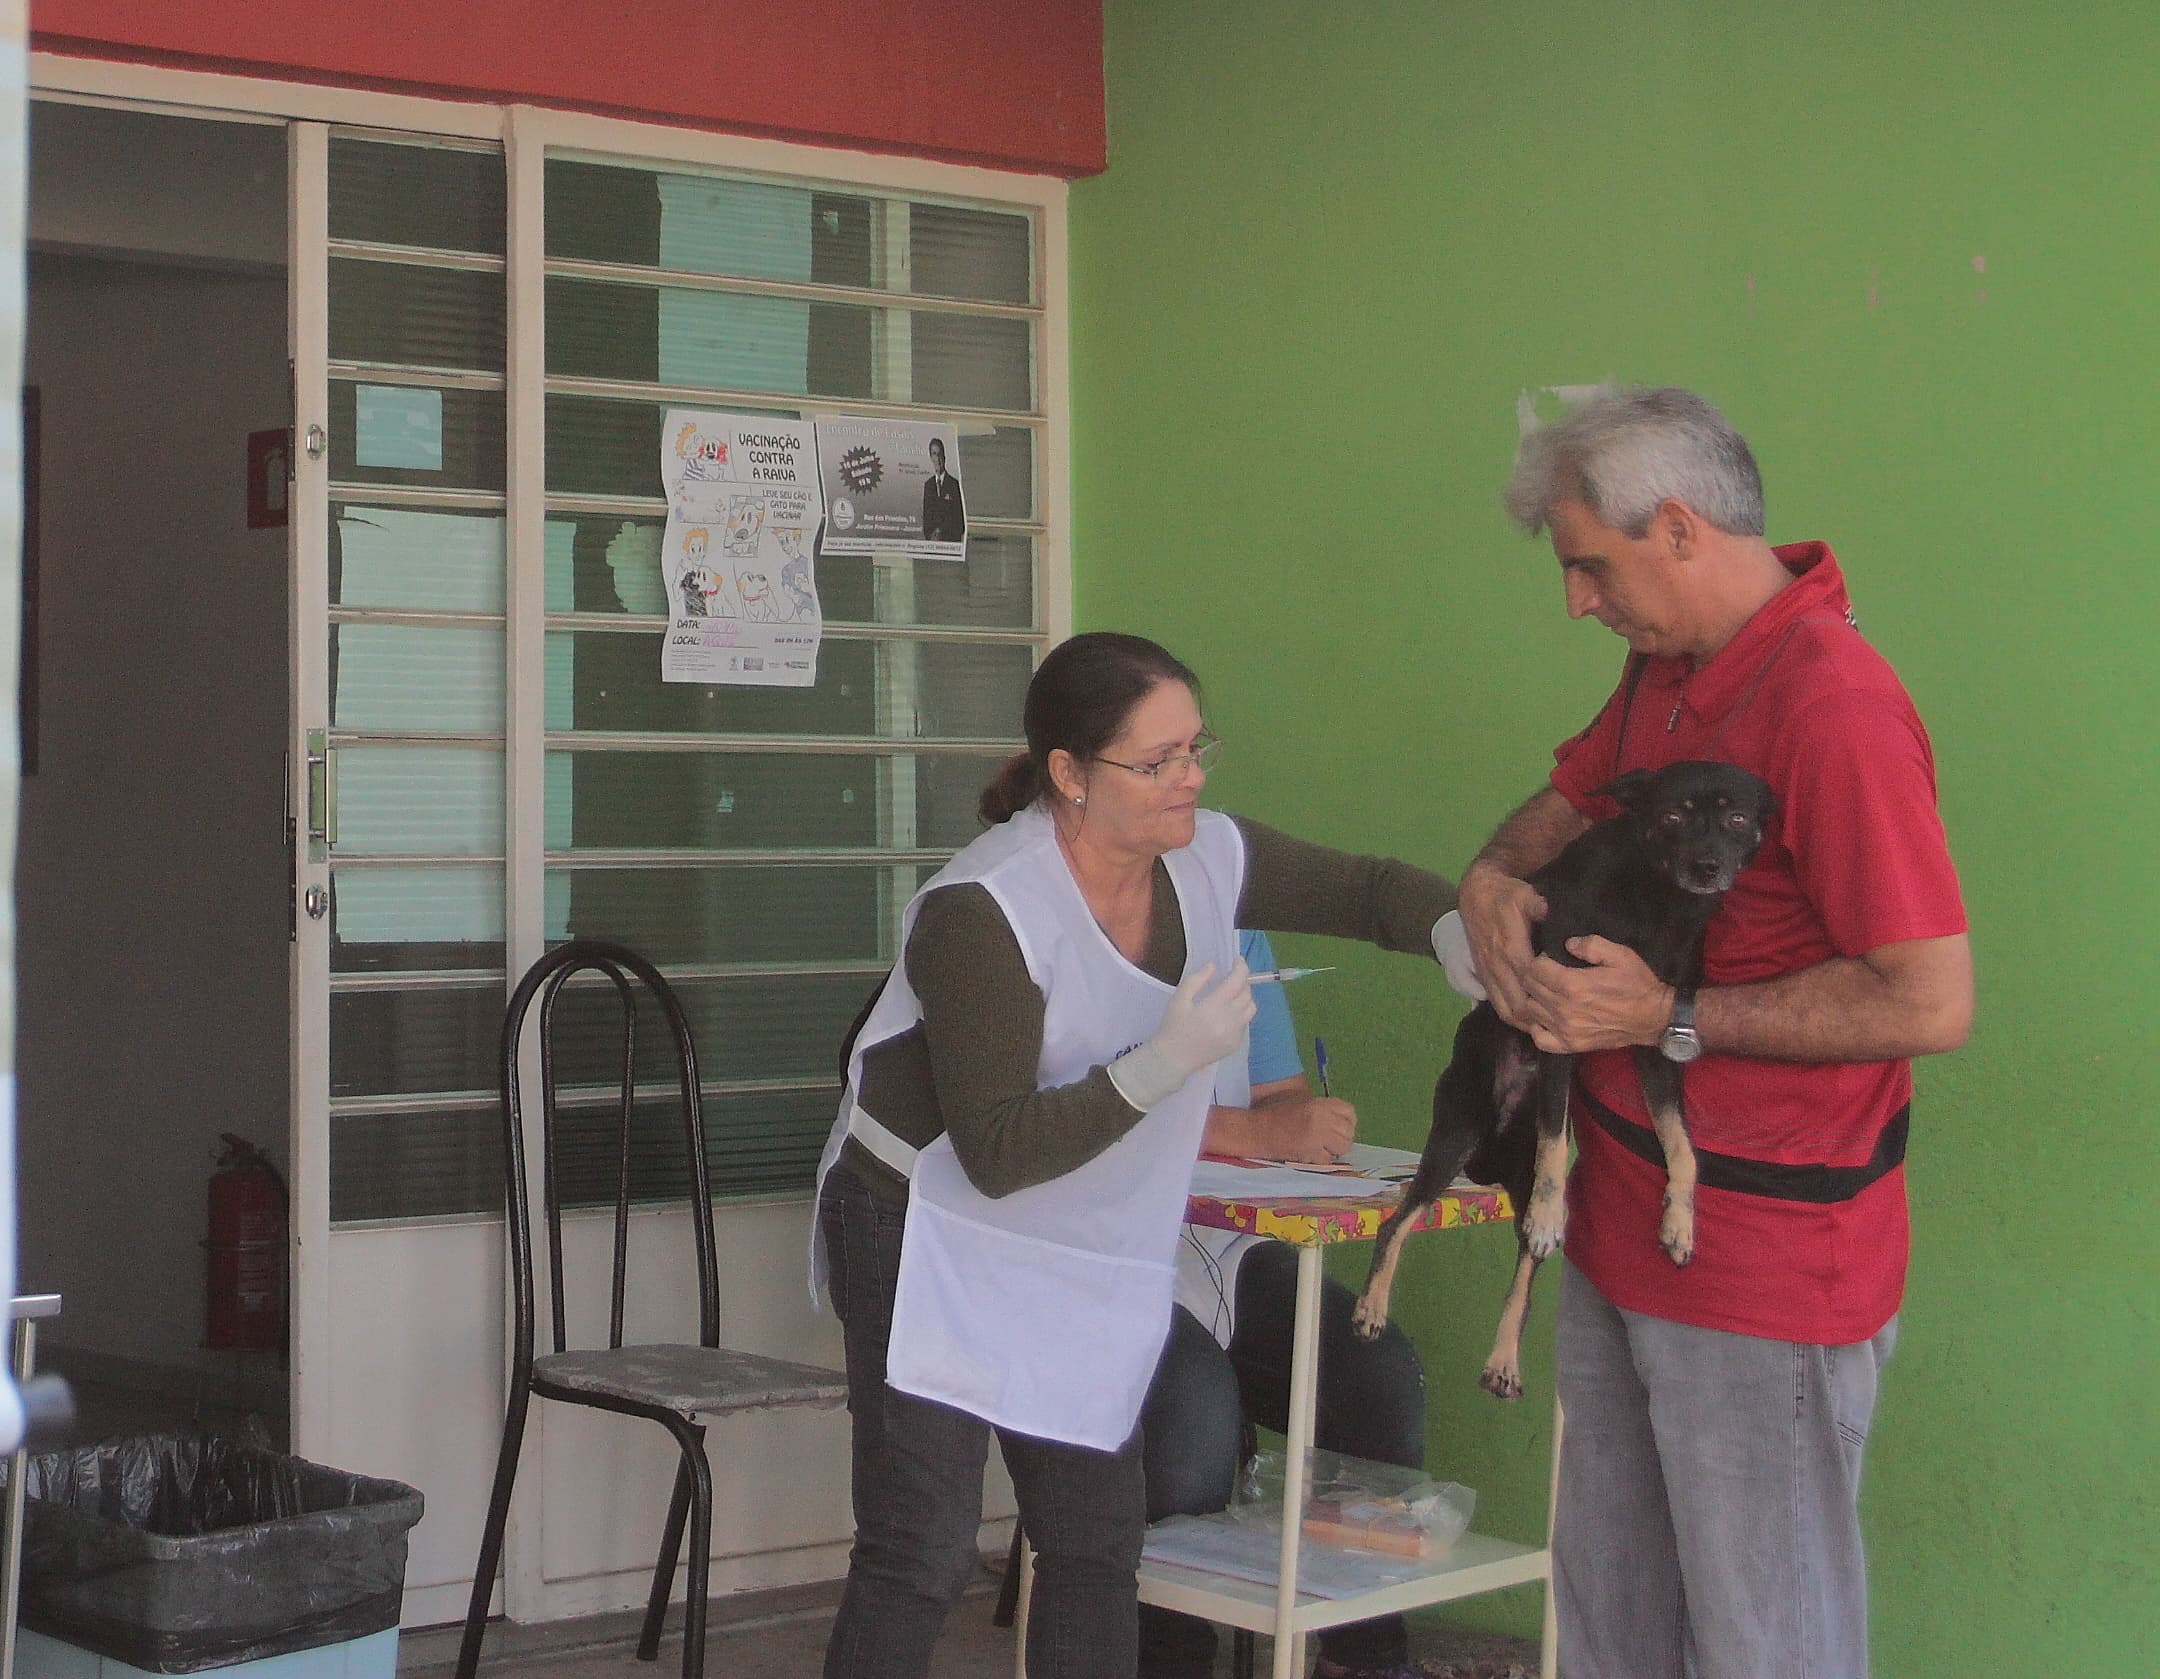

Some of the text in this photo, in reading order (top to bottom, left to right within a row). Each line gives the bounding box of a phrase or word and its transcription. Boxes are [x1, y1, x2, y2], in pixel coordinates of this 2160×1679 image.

[738, 433, 800, 452] VACINAÇÃO
[749, 451, 794, 466] CONTRA
[753, 468, 796, 481] A RAIVA
[762, 489, 778, 498] LEVE
[779, 490, 792, 499] SEU
[793, 490, 807, 500] CÃO
[770, 500, 806, 511] GATO PARA
[677, 619, 700, 629] DATA:
[672, 636, 701, 646] LOCAL:
